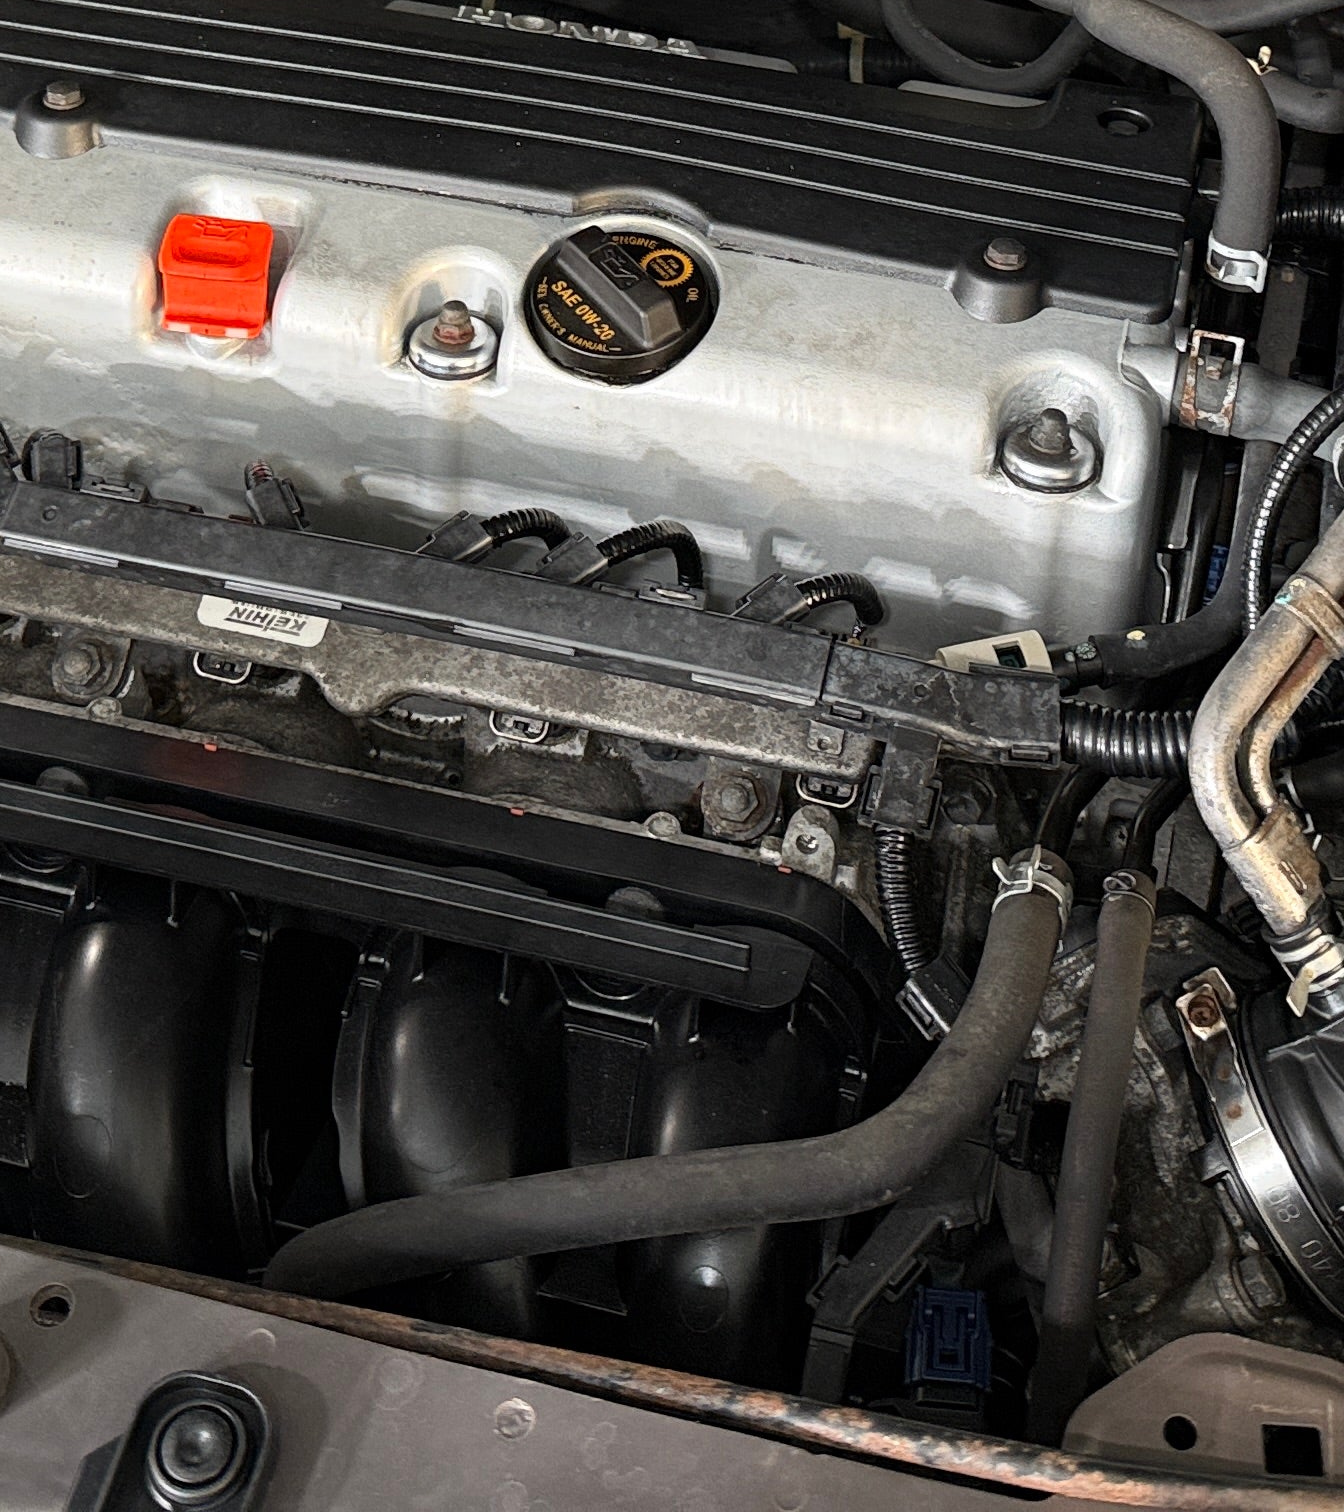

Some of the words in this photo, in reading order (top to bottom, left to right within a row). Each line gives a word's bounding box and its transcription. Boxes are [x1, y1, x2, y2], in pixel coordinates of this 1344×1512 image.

[452, 4, 708, 60] HONDA
[611, 235, 658, 249] ENGINE
[551, 280, 583, 307] SAE
[685, 287, 699, 303] OIL
[575, 304, 615, 341] 0W-20
[227, 606, 307, 633] KEIHIN
